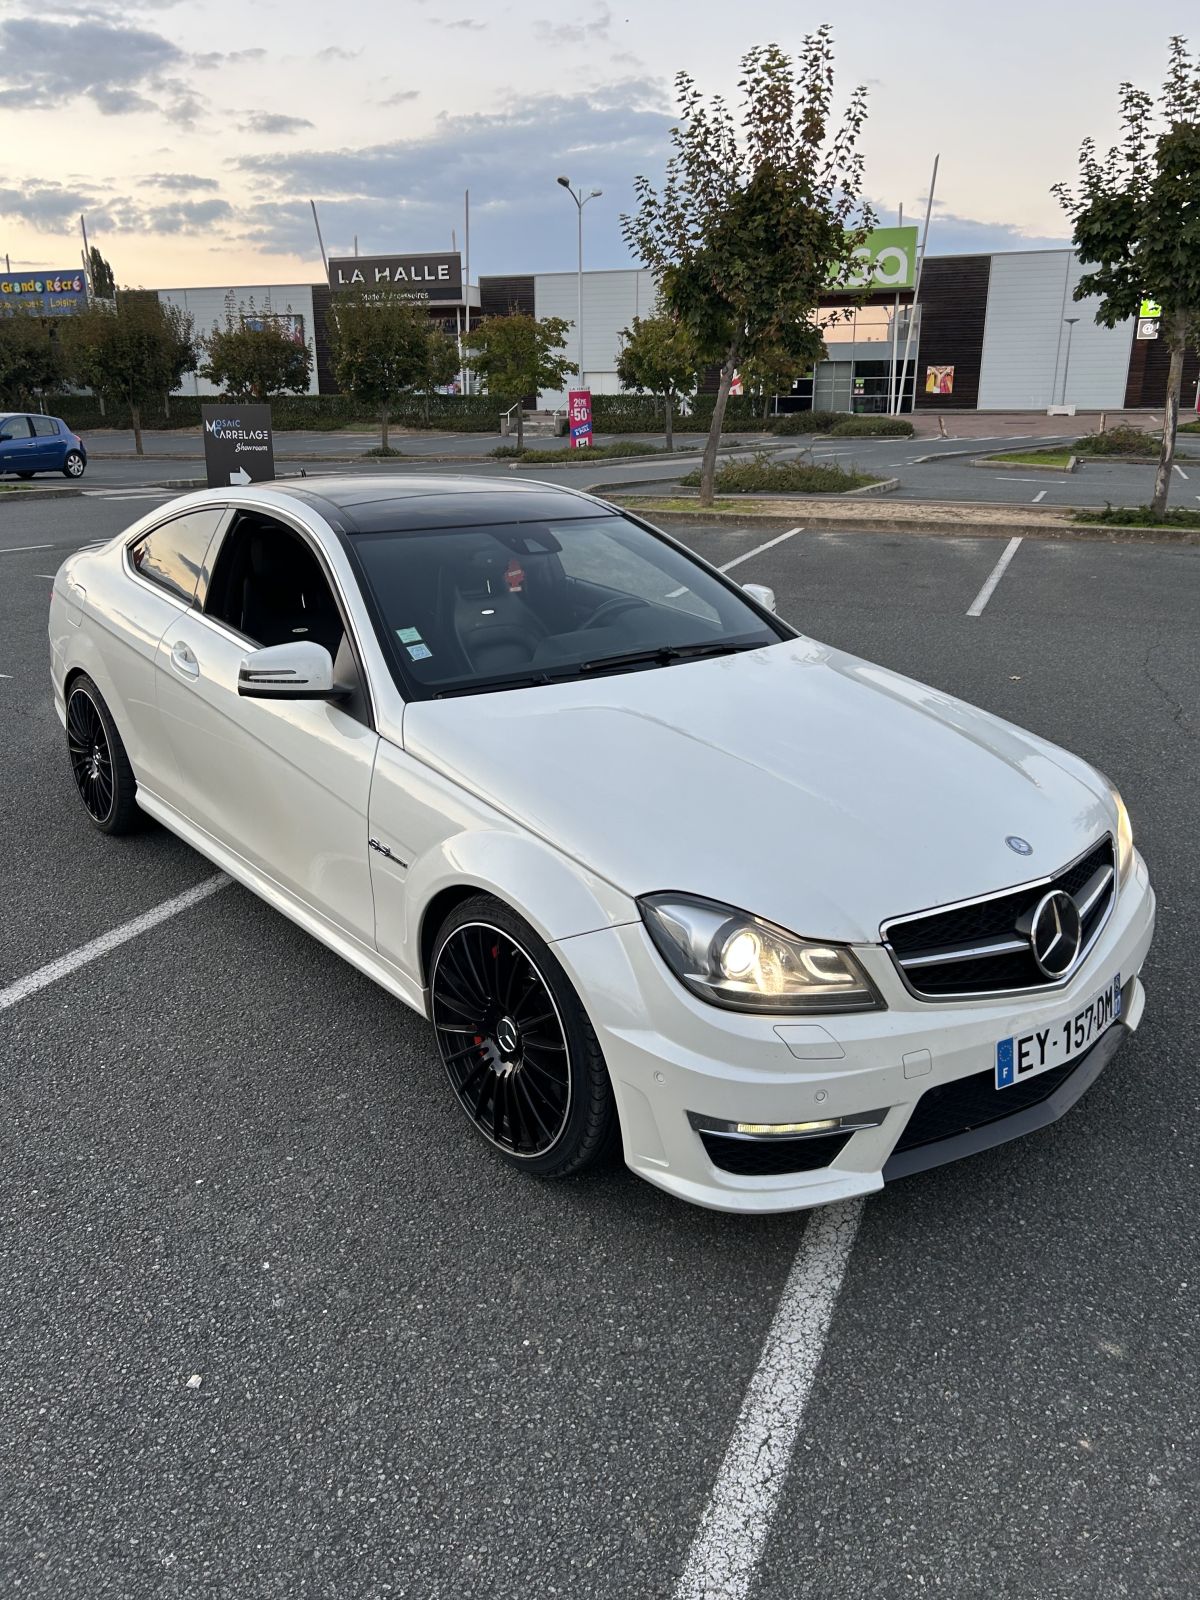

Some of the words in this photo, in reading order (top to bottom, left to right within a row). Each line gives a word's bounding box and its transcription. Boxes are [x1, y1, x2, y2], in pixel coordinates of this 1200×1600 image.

[338, 268, 365, 284] LA
[374, 264, 450, 282] HALLE
[1, 280, 44, 294] Grande
[46, 276, 82, 292] Récré
[205, 419, 241, 432] MOSAIC
[213, 426, 269, 440] CARRELAGE
[234, 442, 268, 453] Showroom
[1002, 1067, 1009, 1079] F
